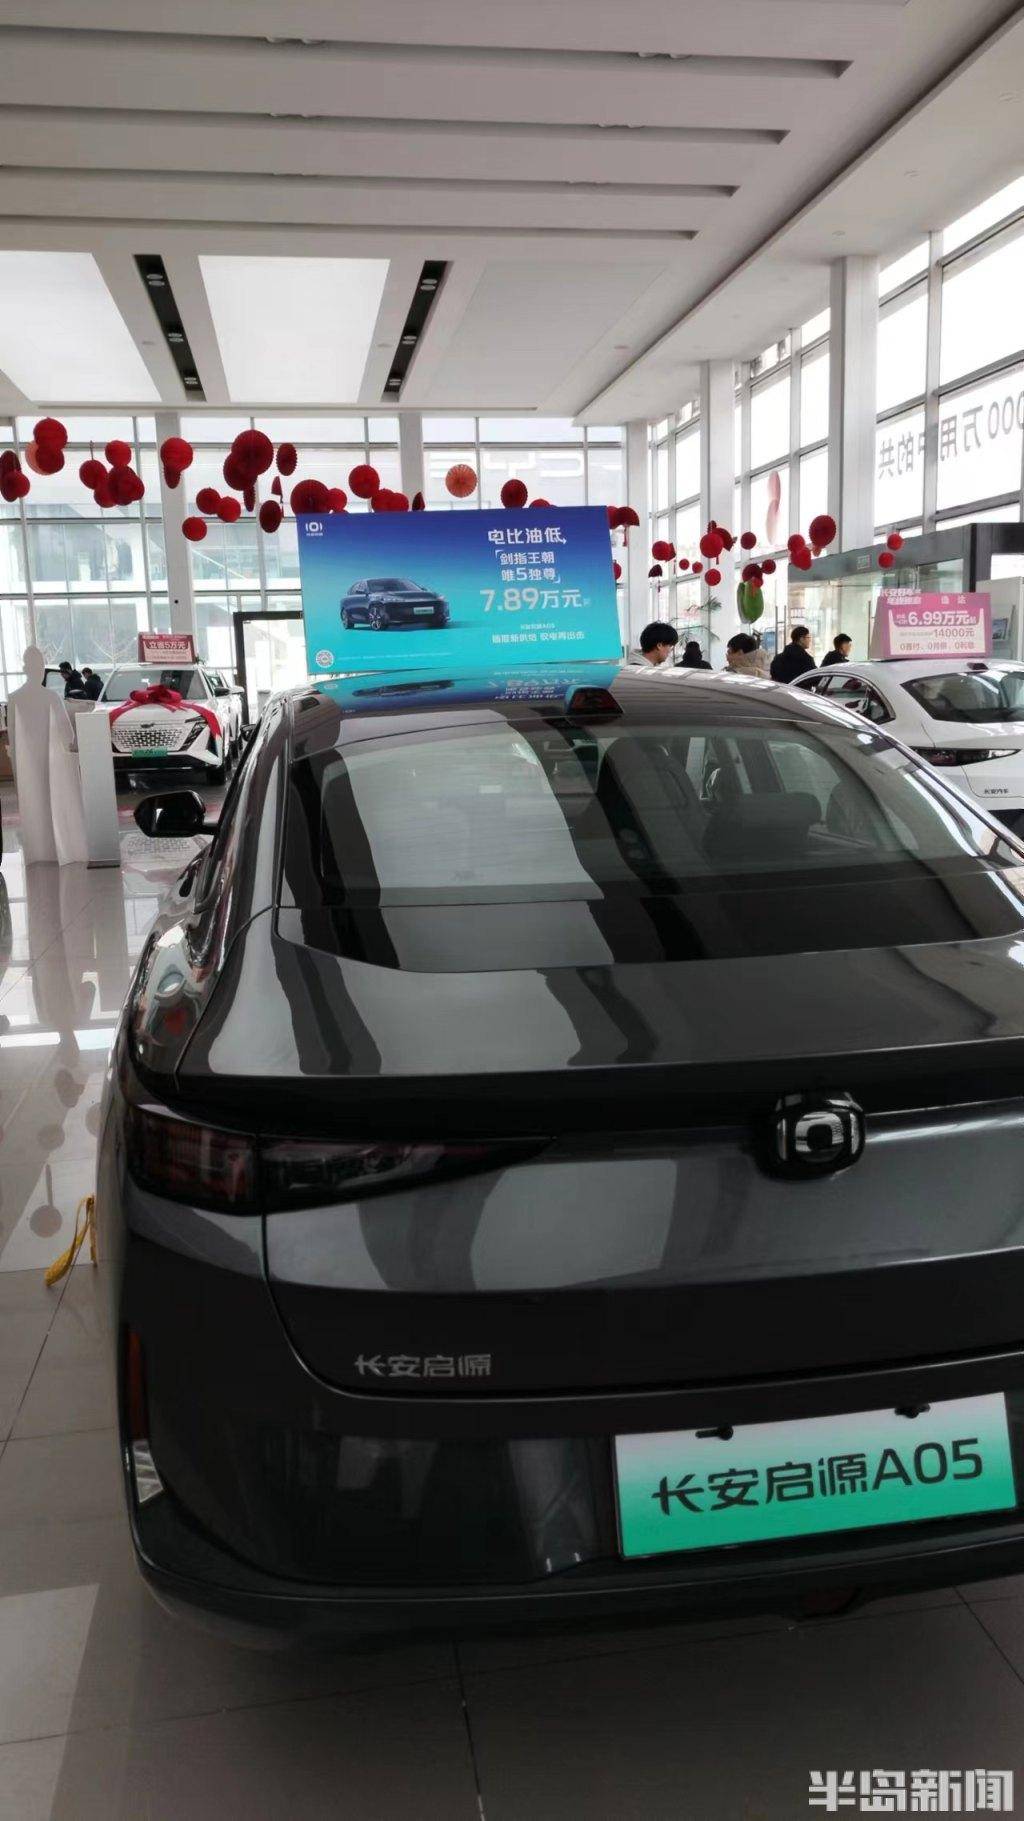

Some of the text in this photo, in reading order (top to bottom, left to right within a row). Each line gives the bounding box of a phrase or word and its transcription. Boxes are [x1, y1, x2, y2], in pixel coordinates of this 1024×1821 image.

[354, 1353, 492, 1378] 长安启源
[651, 1438, 983, 1517] 长安启源A05
